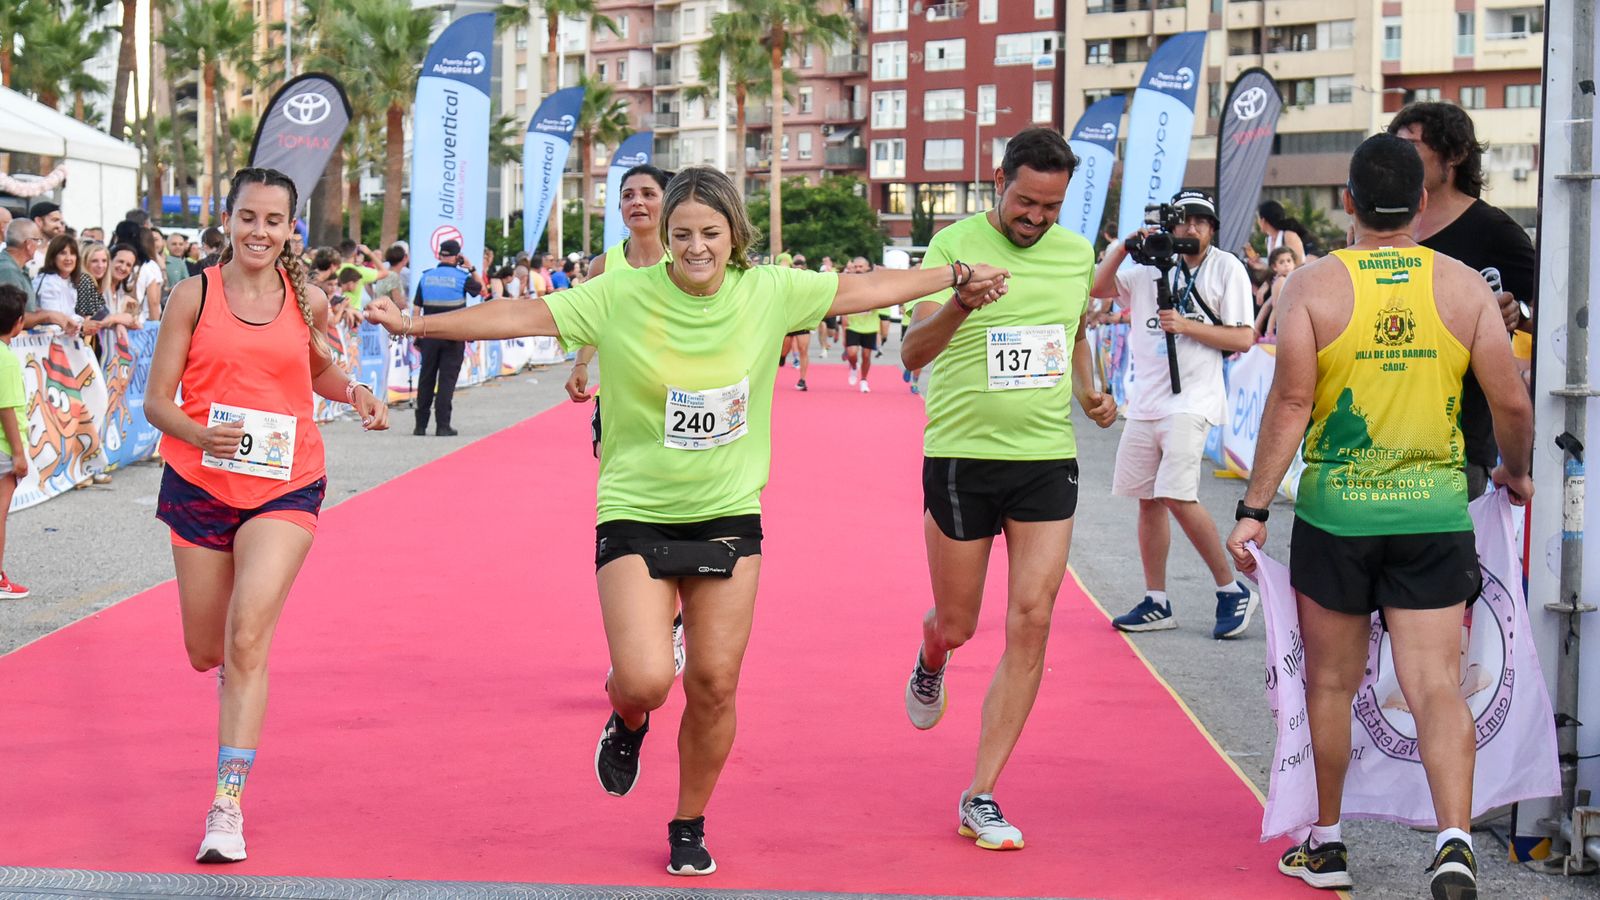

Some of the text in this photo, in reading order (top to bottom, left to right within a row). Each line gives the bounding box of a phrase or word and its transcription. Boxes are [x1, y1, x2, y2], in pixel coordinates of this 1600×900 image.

[432, 63, 472, 75] Algeciras
[277, 131, 330, 151] TOMAX
[438, 89, 459, 219] lalineavertical
[1358, 256, 1422, 270] BARREÑOS
[991, 333, 1006, 342] XXI
[995, 349, 1032, 371] 137
[1355, 348, 1438, 360] VILLA DE LOS BARRIOS
[671, 391, 687, 403] XXI
[213, 409, 229, 421] XXI
[672, 410, 715, 433] 240
[1337, 447, 1435, 460] FISIOTERAPIA
[1346, 478, 1436, 490] 956 62 00 62
[1342, 489, 1431, 501] LOS BARRIOS
